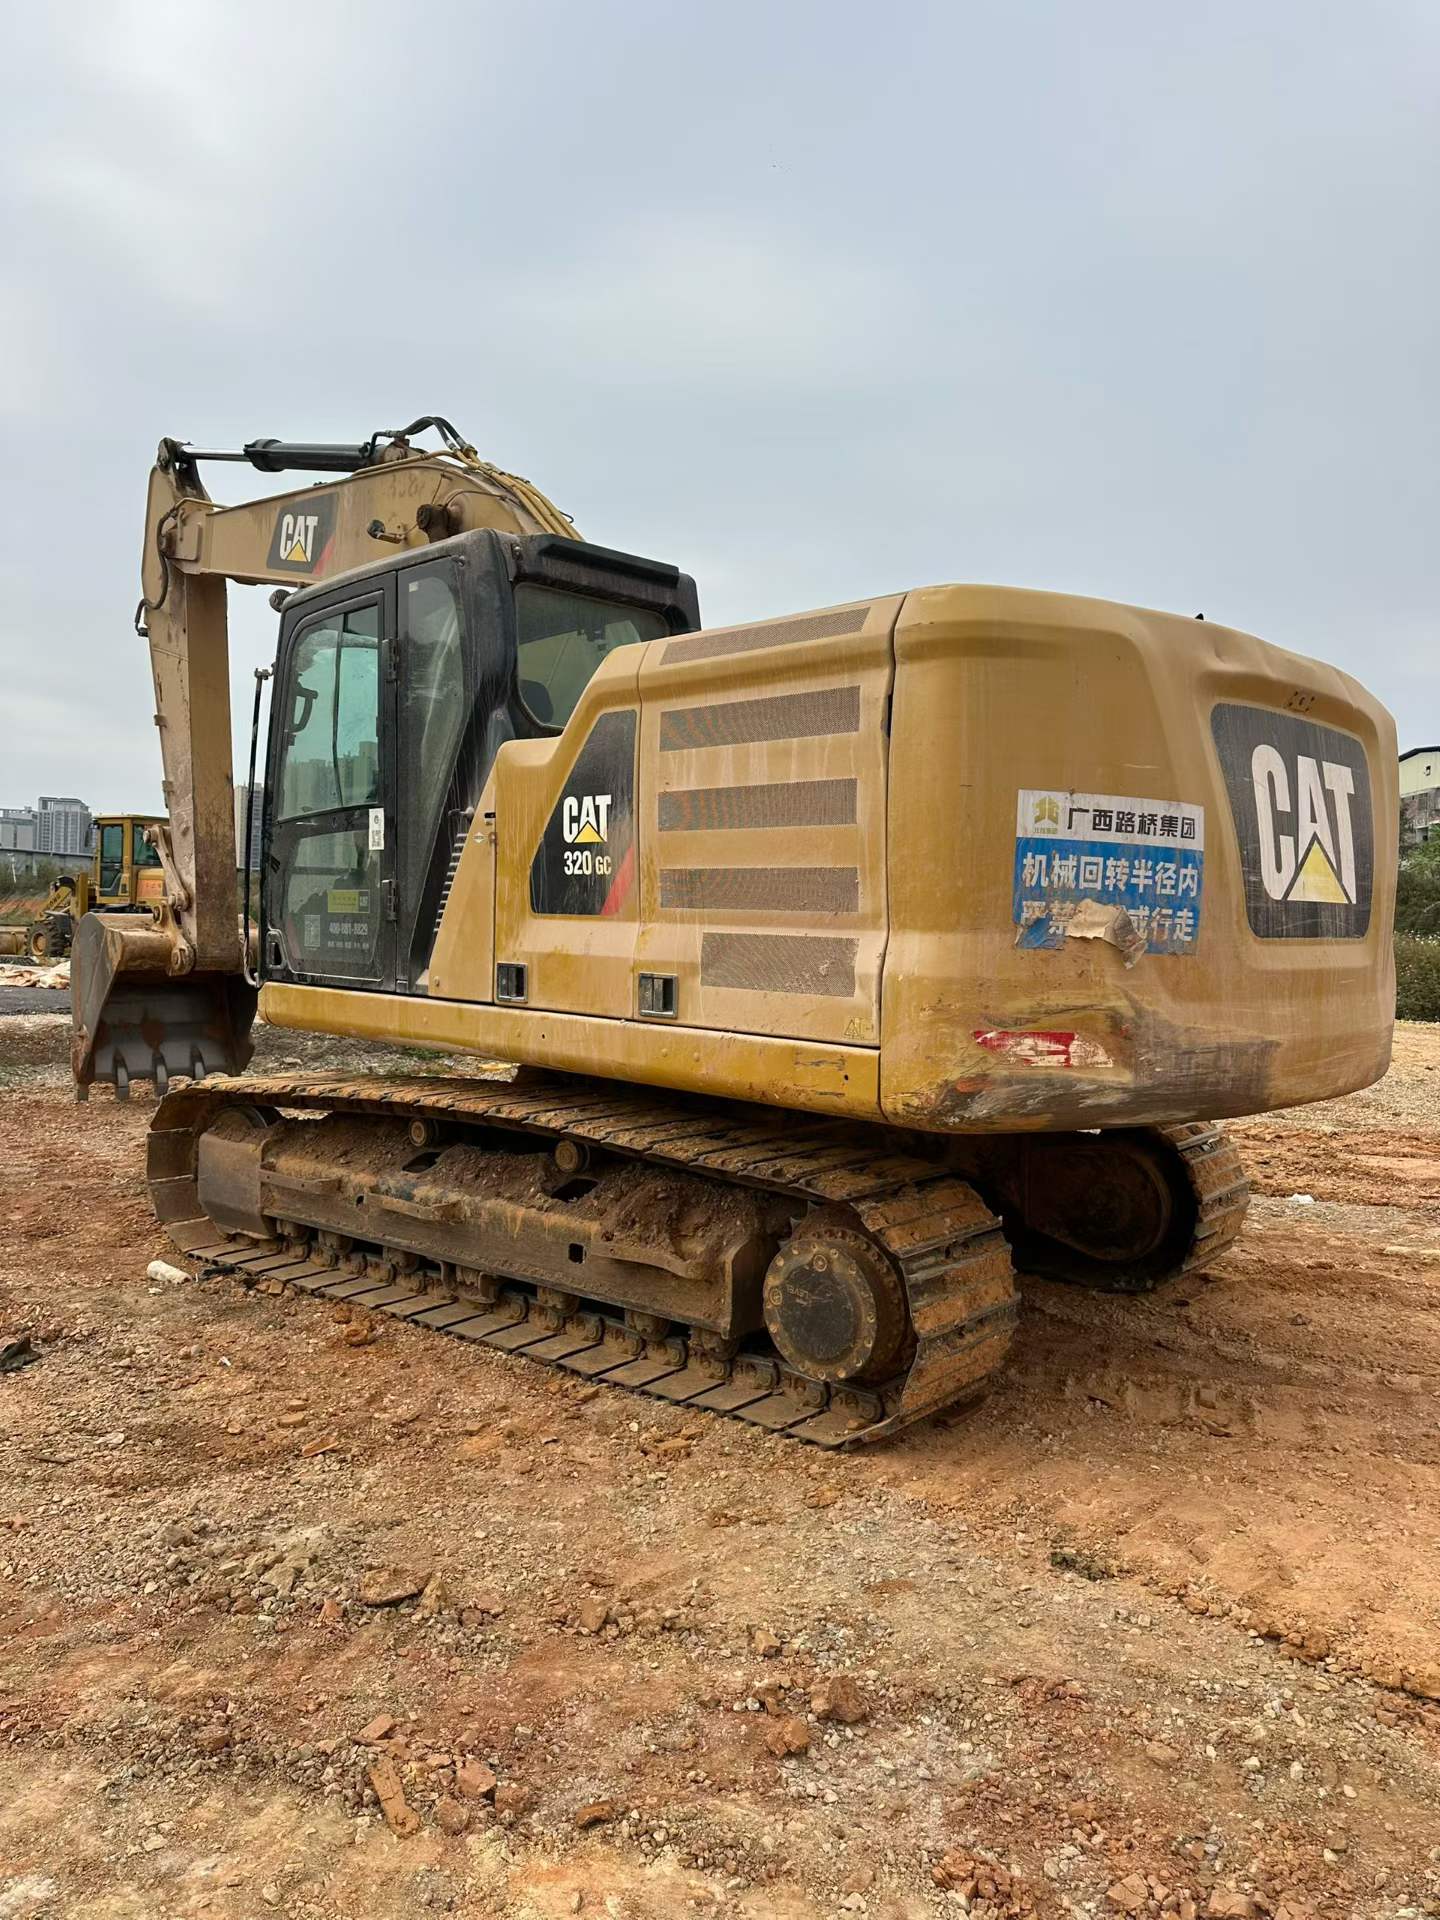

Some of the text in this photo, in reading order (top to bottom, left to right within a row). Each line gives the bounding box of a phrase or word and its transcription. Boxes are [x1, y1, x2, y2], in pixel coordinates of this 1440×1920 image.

[280, 514, 318, 562] CAT
[563, 795, 611, 843] CAT
[1067, 807, 1195, 839] 广西路桥集团
[1252, 744, 1356, 904] CAT
[564, 851, 611, 875] 320 GC
[1022, 852, 1198, 897] 机械回转半径内
